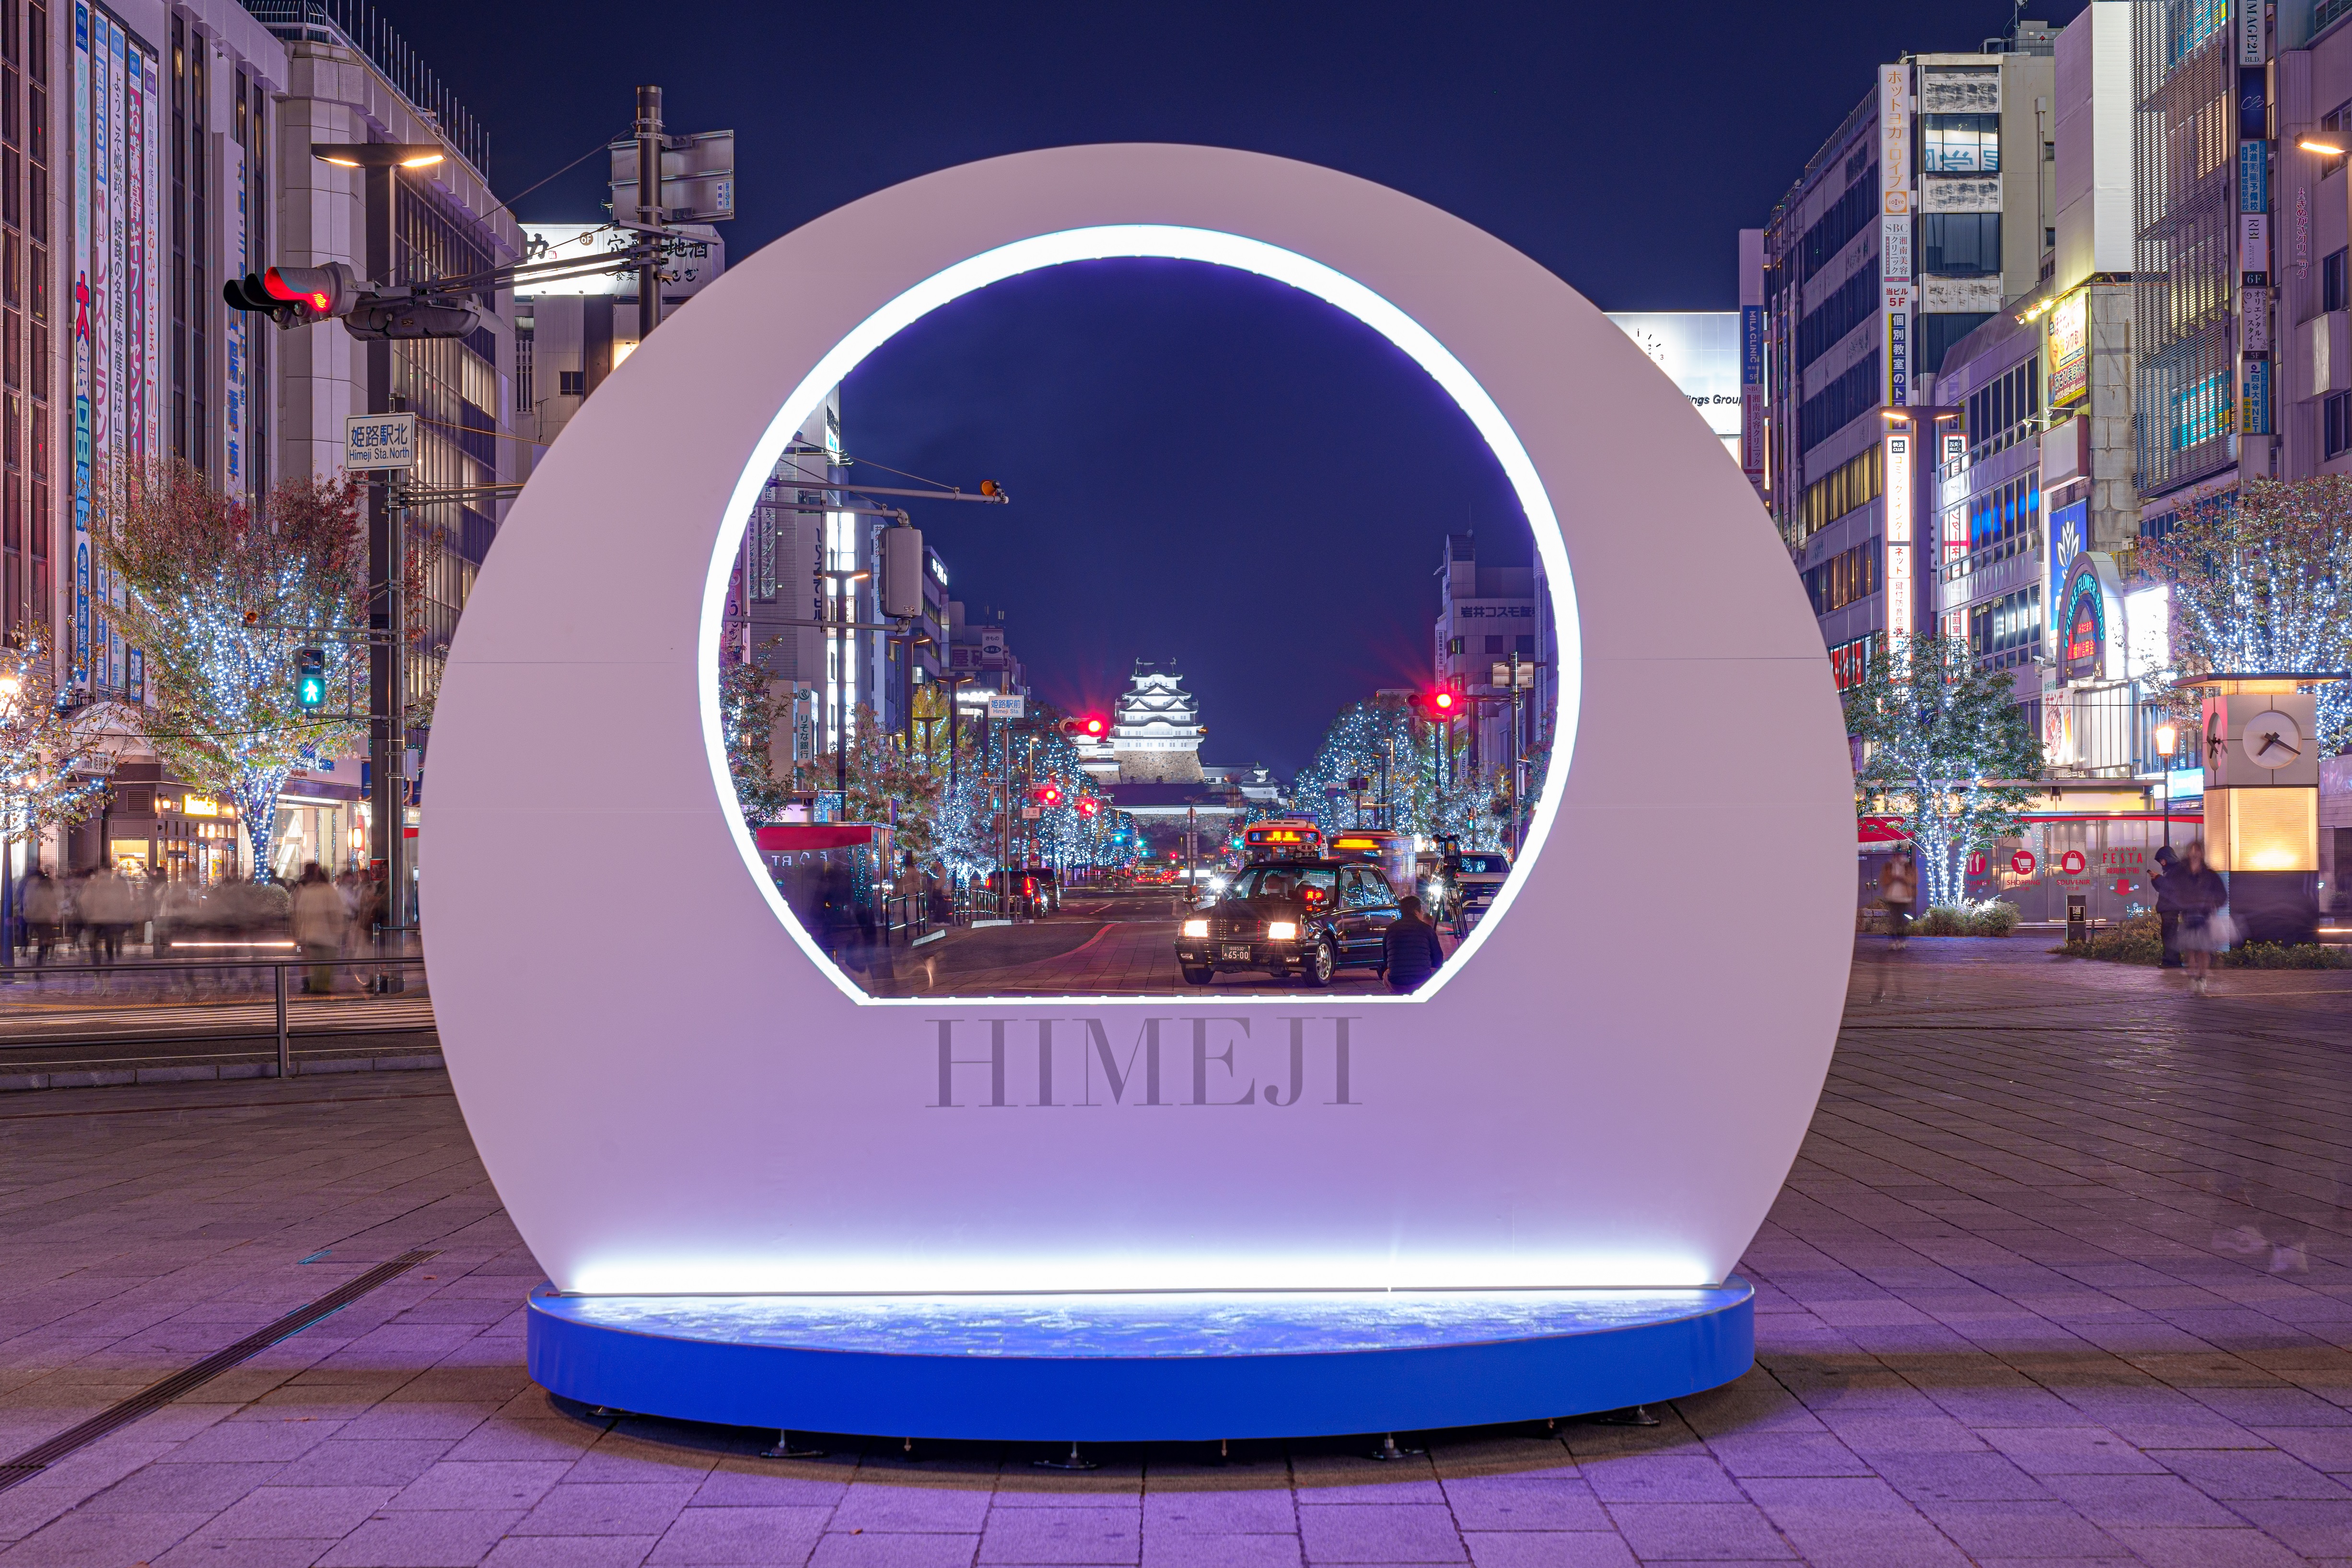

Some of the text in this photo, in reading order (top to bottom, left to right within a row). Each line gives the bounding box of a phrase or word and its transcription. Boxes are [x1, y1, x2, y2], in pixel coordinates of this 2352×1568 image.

[1888, 70, 1904, 188] ホットヨガ・ロイブ
[2243, 150, 2247, 158] 4F
[2243, 165, 2247, 174] 7F
[2249, 143, 2259, 211] 東進衛星予備校
[581, 234, 592, 244] 6F
[1885, 223, 1908, 233] SBC
[2248, 219, 2259, 244] RBL
[2296, 199, 2308, 279] きぬがさクリニック
[1890, 236, 1899, 275] クリニック
[1899, 236, 1908, 275] 湘南美容
[2247, 274, 2262, 284] 6F
[1889, 298, 1905, 307] 5F
[2247, 320, 2255, 350] スタイル
[2251, 374, 2260, 432] 四谷大塚NET
[351, 423, 408, 447] 姫路駅北
[1752, 395, 1761, 467] 湘南美容クリニック
[349, 447, 409, 462] Himeji Sta. North
[2065, 573, 2105, 648] EKIMAE FLOWER ROAD
[991, 699, 1021, 709] 姫路駅前
[2045, 691, 2063, 711] ボナンザ
[800, 715, 809, 759] りそな銀行
[2103, 853, 2143, 864] FESTA
[925, 1017, 1362, 1107] HIMEJI
